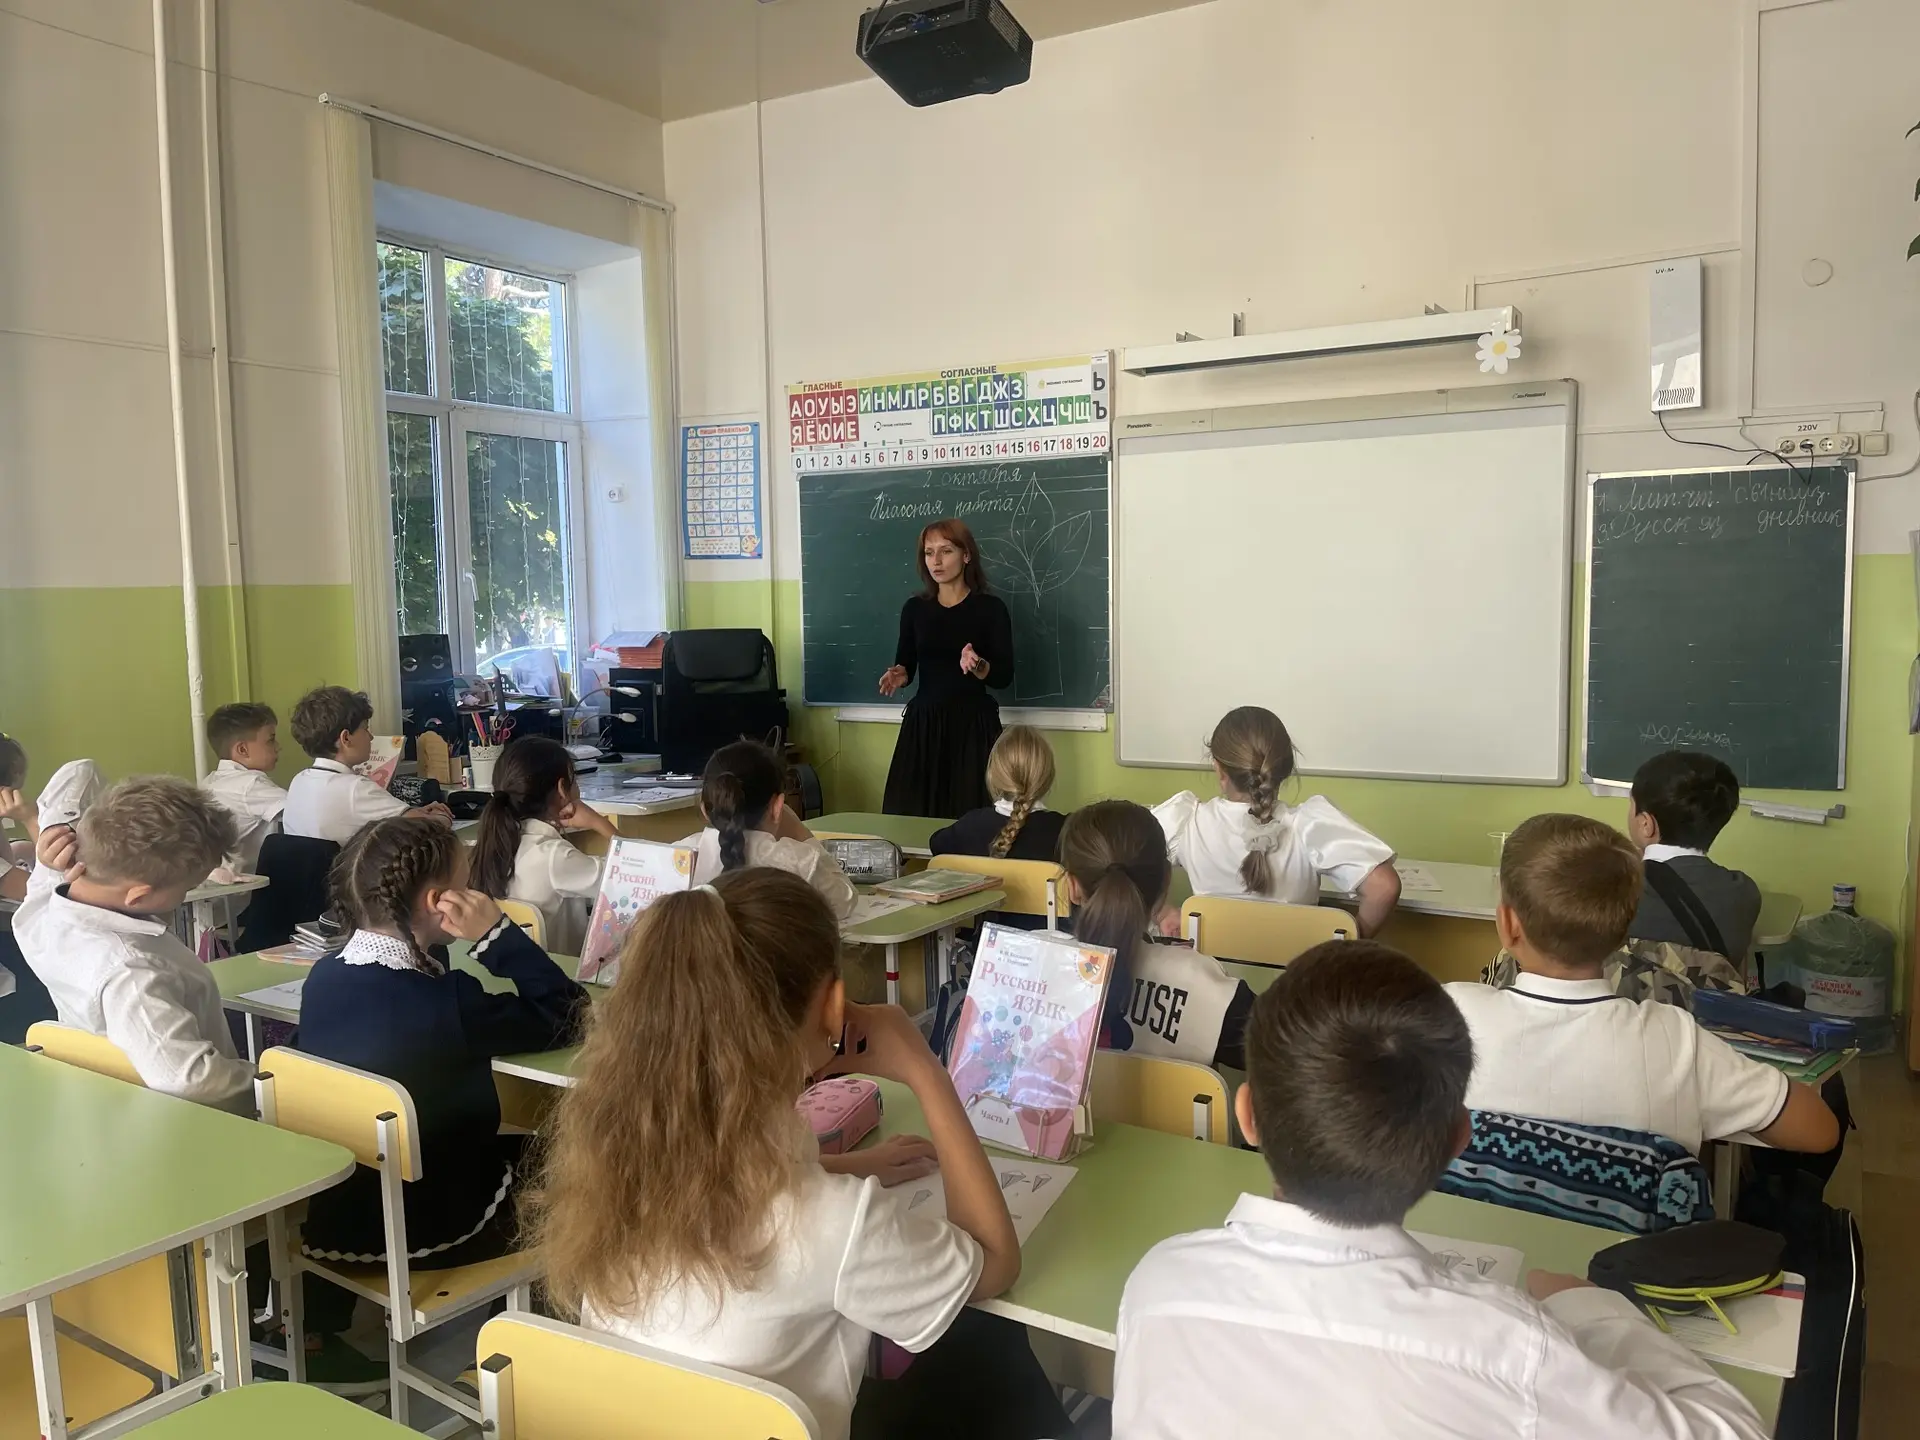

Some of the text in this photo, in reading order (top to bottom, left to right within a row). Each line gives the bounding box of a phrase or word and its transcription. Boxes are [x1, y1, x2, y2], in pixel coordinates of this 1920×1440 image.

[940, 365, 997, 379] СОГЛАСНЫЕ
[791, 379, 1023, 418] А О У Ы Э Й Н М Л Р Б В Г Д Ж З
[803, 381, 842, 392] ГЛАСНЫЕ
[933, 401, 1090, 433] П Ф К Т Ш С Х Ц Ч Щ
[1797, 423, 1818, 432] 220V
[792, 421, 857, 444] Я Ё Ю И Е
[796, 435, 1107, 468] 0 1 2 3 4 5 6 7 8 9 10 11 12 13 14 15 16 17 18 19 20
[922, 464, 1023, 489] 2 октября
[869, 489, 1015, 520] Классная работа
[1757, 500, 1846, 535] дневник
[608, 864, 656, 886] Русский
[978, 959, 1049, 995] Русский
[1130, 978, 1189, 1044] USE
[979, 1109, 1004, 1124] Часть
